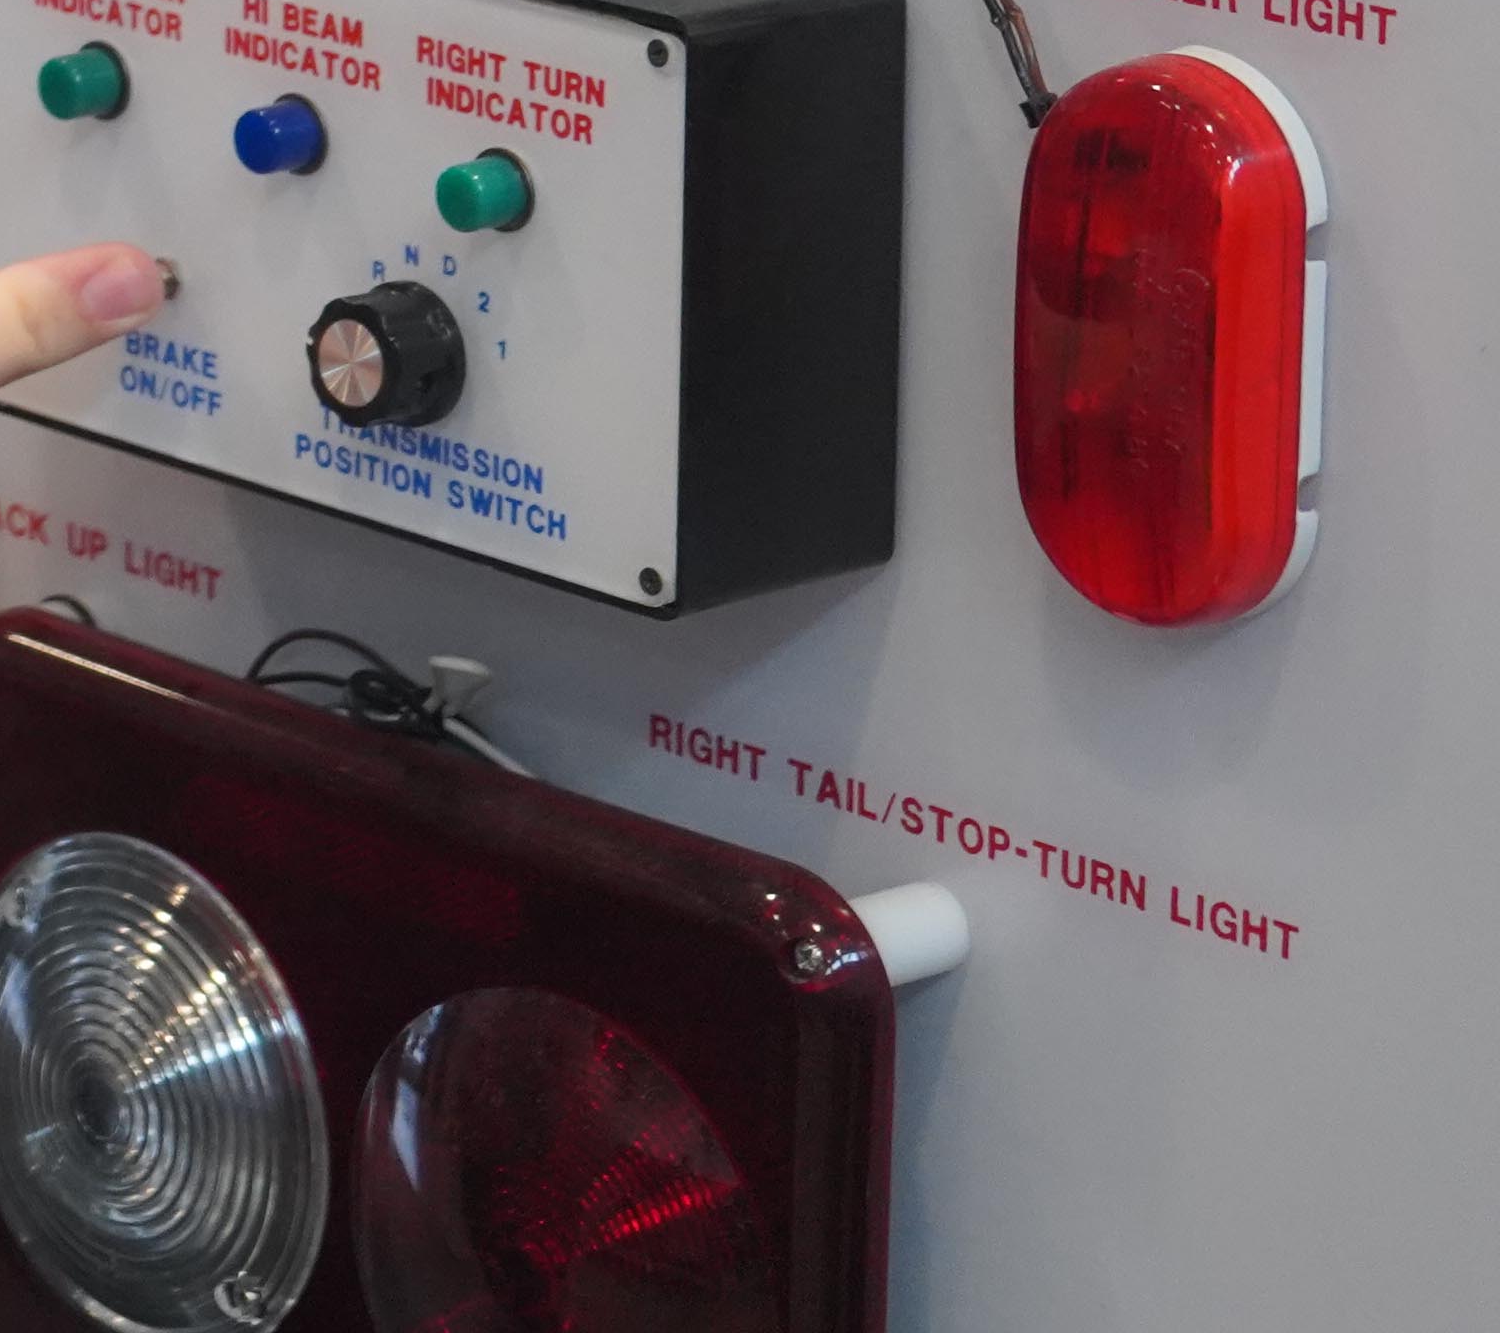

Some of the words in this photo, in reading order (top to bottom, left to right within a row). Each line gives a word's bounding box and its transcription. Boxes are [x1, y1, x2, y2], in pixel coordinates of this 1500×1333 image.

[225, 28, 381, 92] INDICATOR
[282, 2, 364, 49] BEAM
[417, 36, 506, 83] RIGHT
[522, 60, 606, 109] TURN
[426, 77, 594, 145] INDICATOR
[372, 260, 386, 281] R
[405, 244, 420, 267] N
[443, 255, 457, 277] D
[478, 291, 491, 313] 2
[497, 339, 507, 360] 1
[125, 329, 219, 382] BRAKE
[120, 369, 223, 417] ON/OFF
[295, 433, 432, 499] POSITION
[448, 480, 567, 540] SWITCH
[66, 521, 108, 562] UP
[124, 541, 222, 601] LIGHT
[649, 714, 766, 781] RIGHT
[787, 757, 1146, 912] TAIL/STOP-TURN
[1170, 885, 1299, 959] LIGHT
